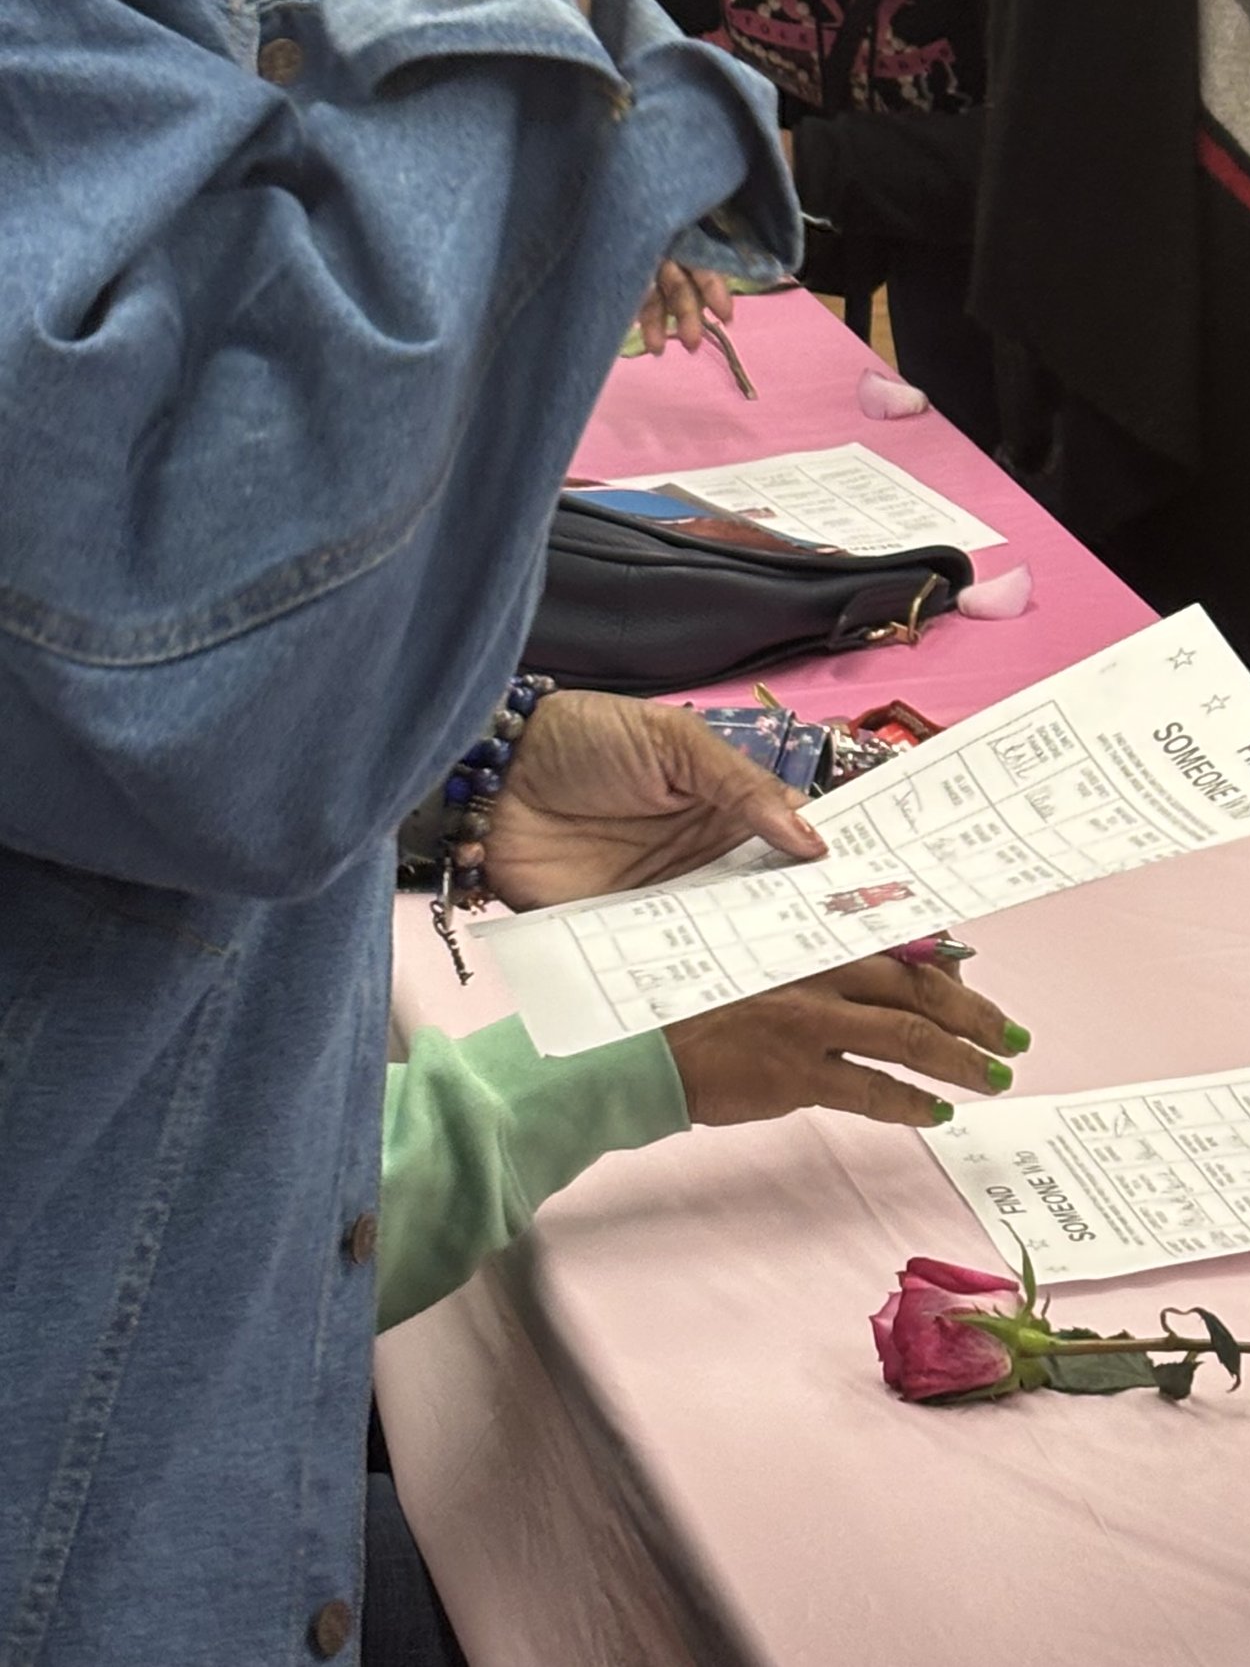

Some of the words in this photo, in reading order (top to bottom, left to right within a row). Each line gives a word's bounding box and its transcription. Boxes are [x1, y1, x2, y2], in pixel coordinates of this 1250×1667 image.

[1152, 721, 1241, 802] SOMEONE
[985, 1185, 1028, 1216] FIND
[1026, 1175, 1097, 1243] SOMEONE
